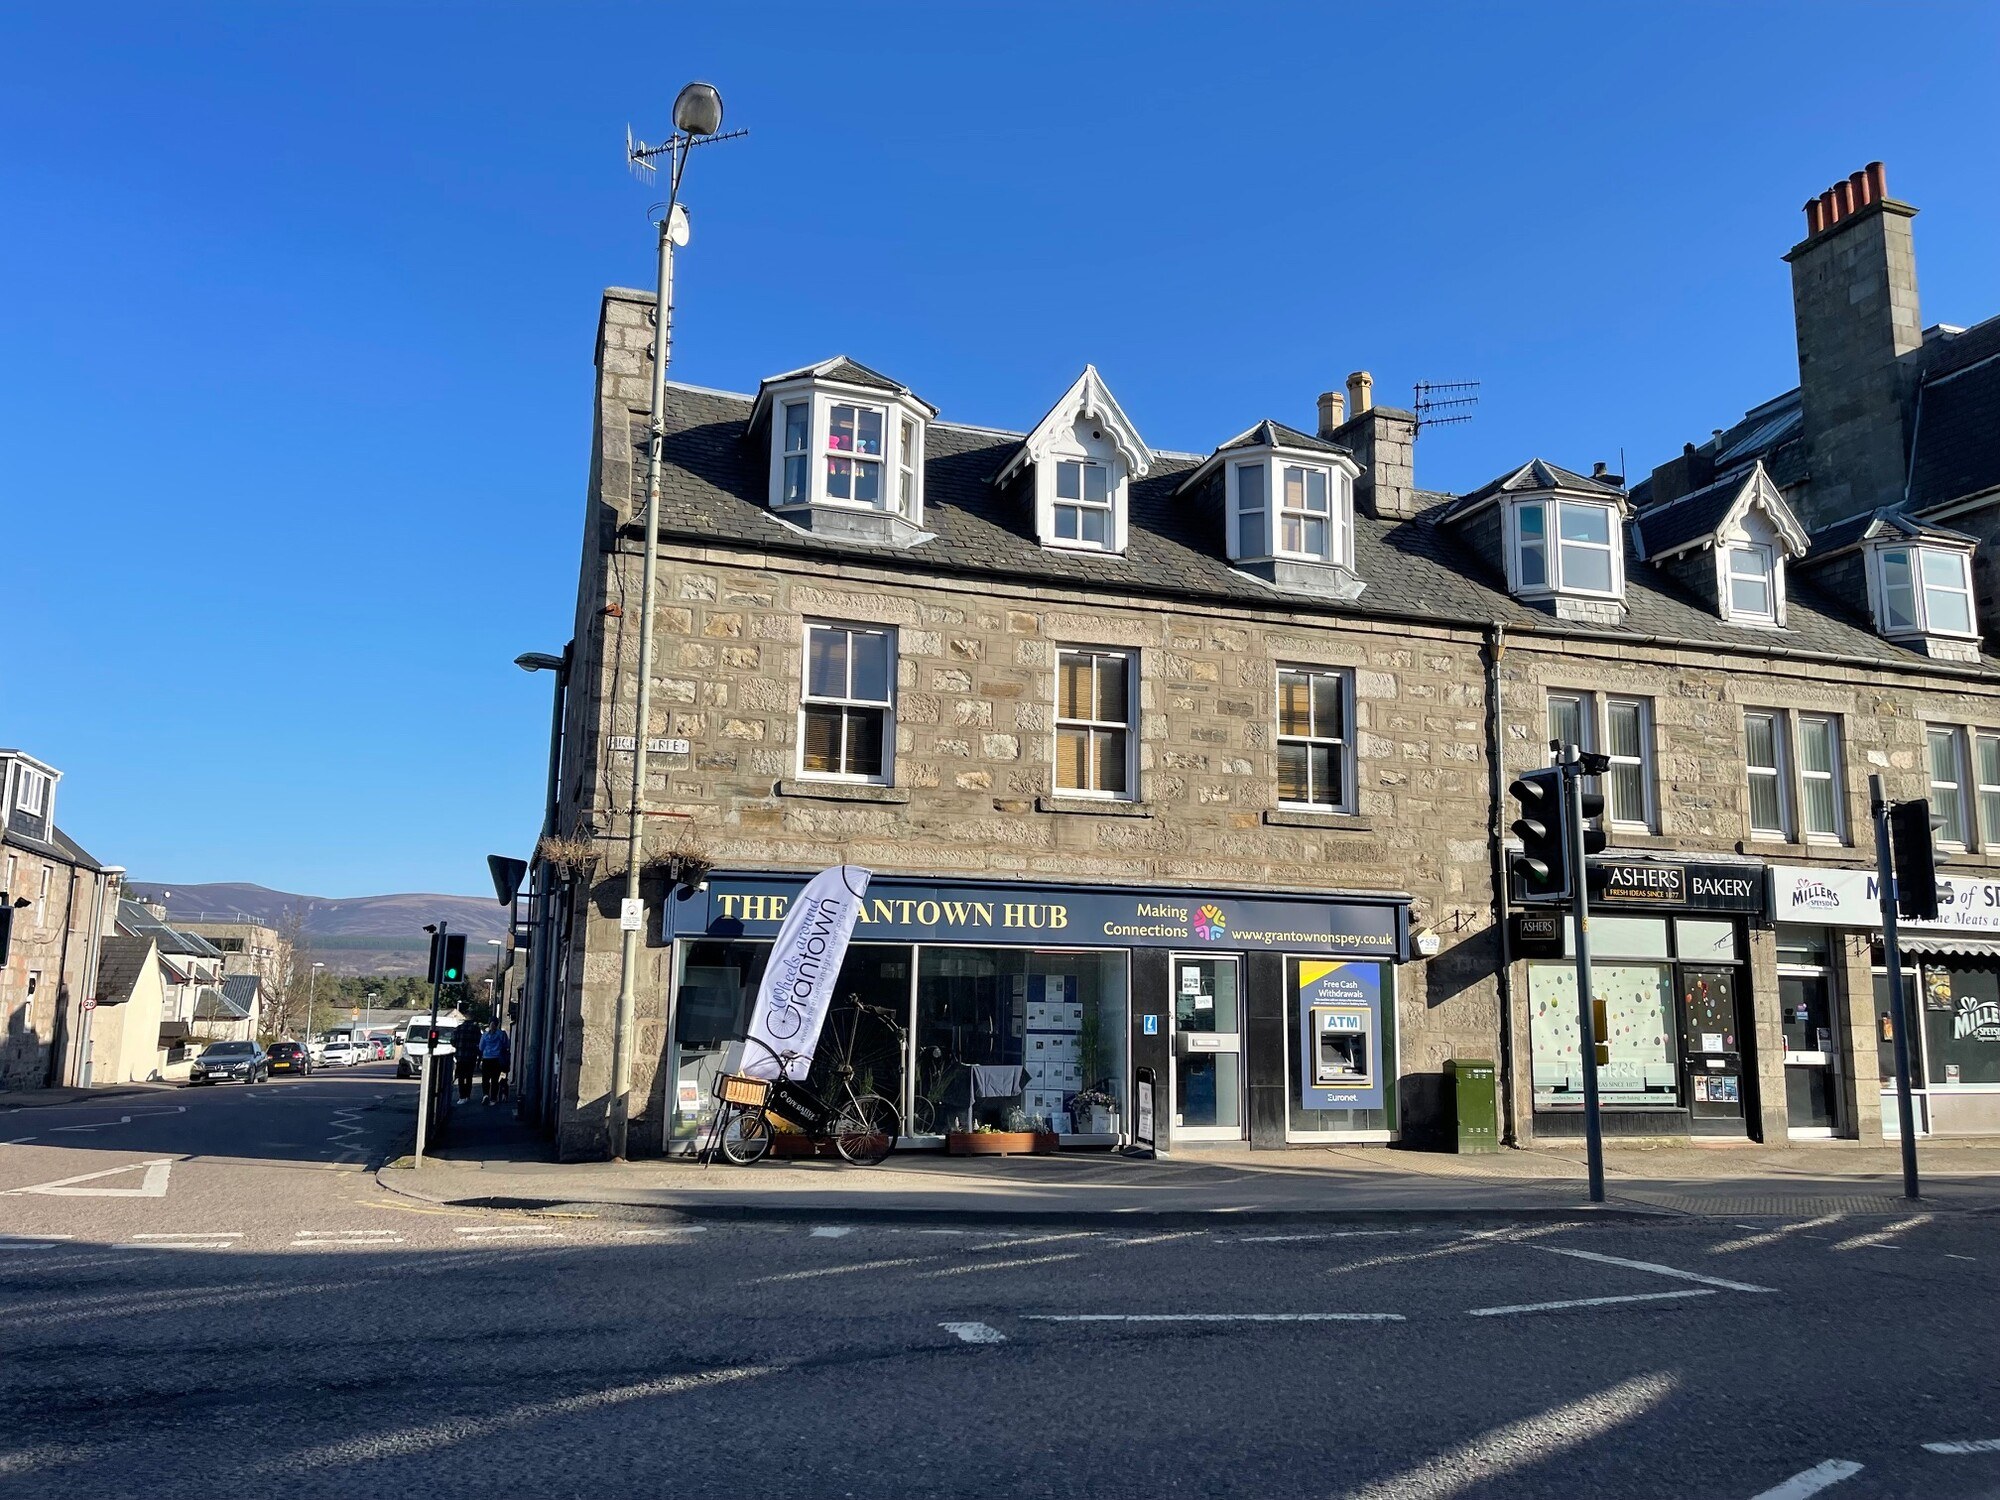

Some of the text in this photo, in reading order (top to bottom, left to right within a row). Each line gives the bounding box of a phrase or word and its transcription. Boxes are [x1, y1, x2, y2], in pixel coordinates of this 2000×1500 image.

[1610, 867, 1753, 897] ASHERS BAKERY
[1610, 888, 1629, 896] FRESH
[1629, 889, 1646, 897] IDEAS
[1647, 890, 1664, 898] SINCE
[1792, 886, 1840, 907] MILLERS
[1961, 885, 1978, 910] of
[717, 894, 1068, 929] THE ANTOWN HUB
[1137, 903, 1189, 922] Making
[1955, 912, 1988, 926] Meats
[1103, 921, 1189, 938] Connections
[1523, 921, 1553, 932] ASHERS
[1231, 930, 1393, 947] www.grantownonspey.co.uk
[769, 896, 821, 1012] Wheels around
[766, 898, 840, 1040] Grantown
[1323, 980, 1340, 988] Free
[1318, 989, 1364, 998] Withdrawals
[1328, 1016, 1358, 1028] ATM
